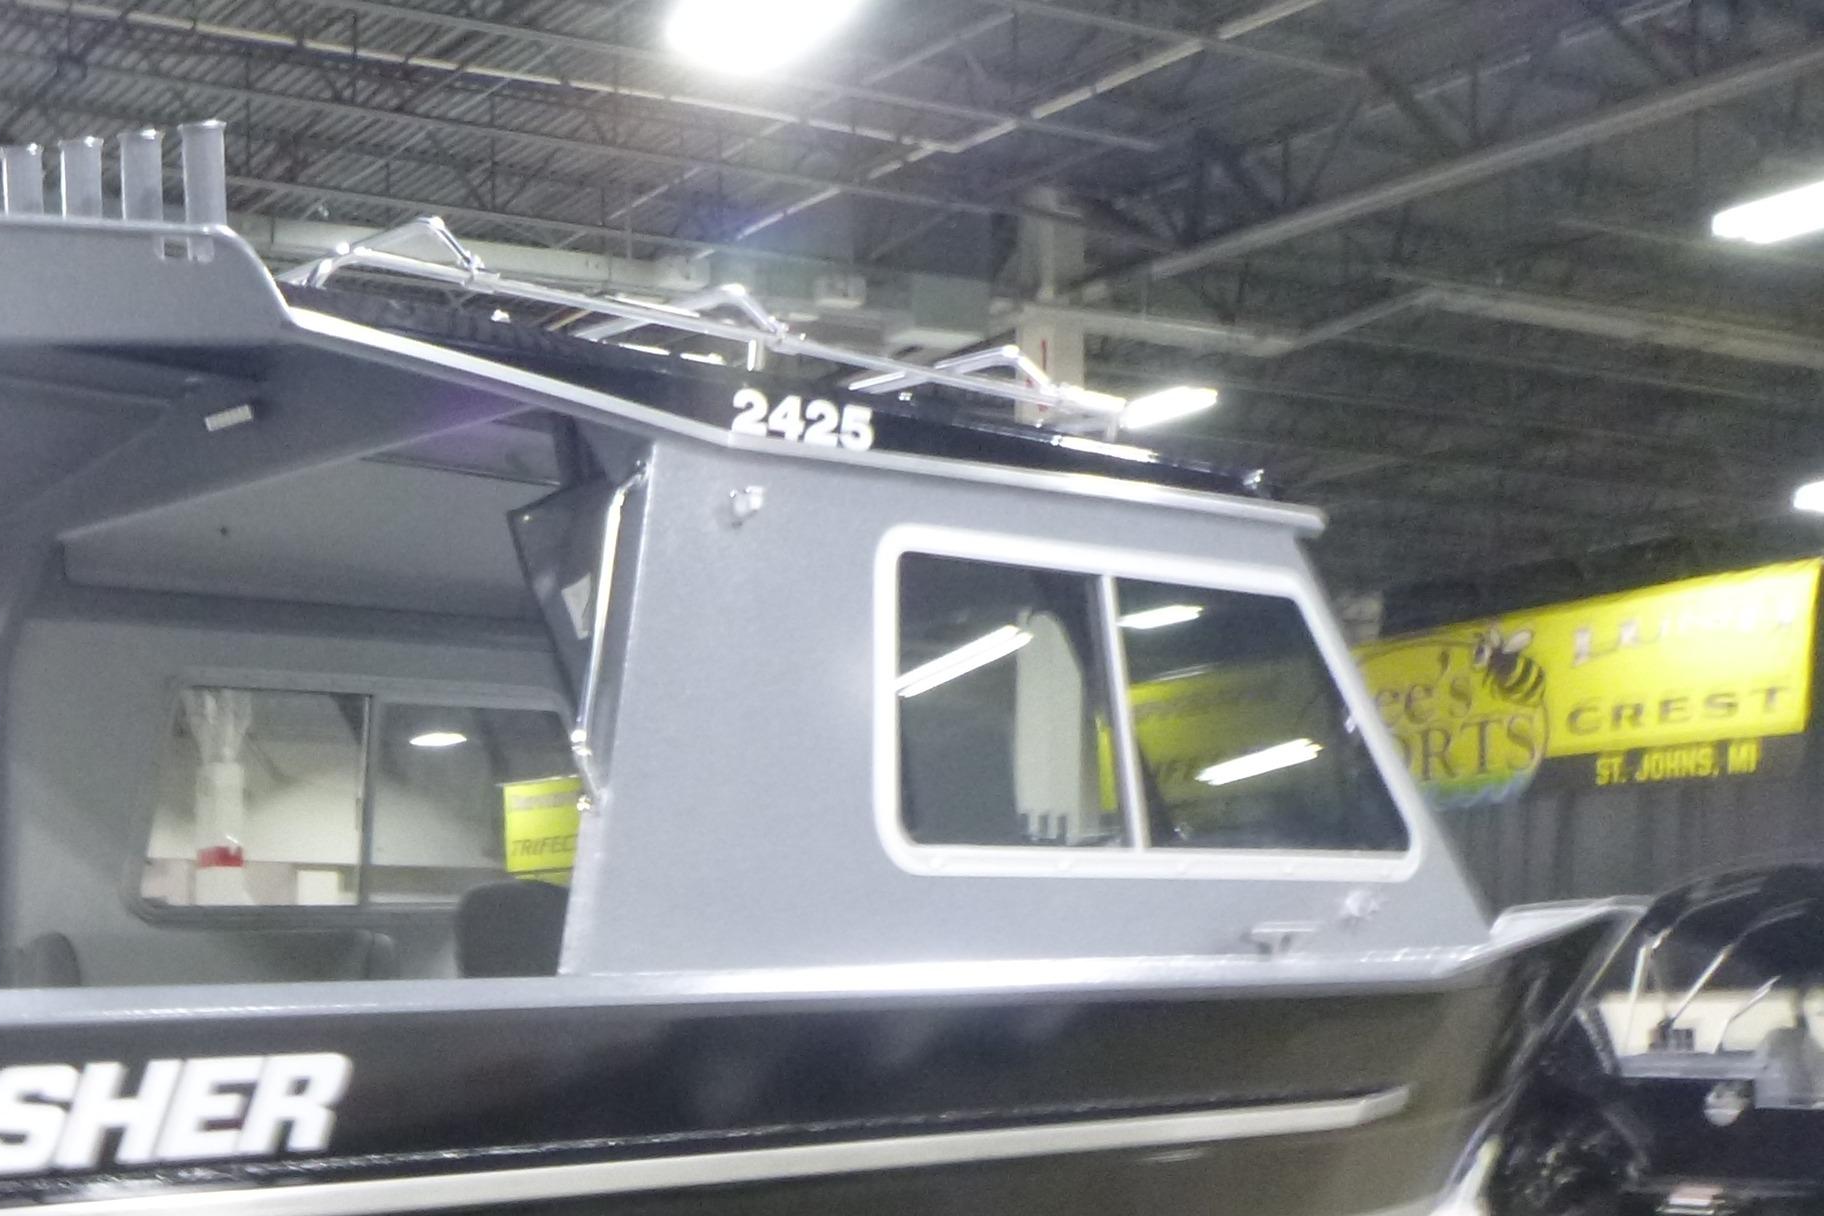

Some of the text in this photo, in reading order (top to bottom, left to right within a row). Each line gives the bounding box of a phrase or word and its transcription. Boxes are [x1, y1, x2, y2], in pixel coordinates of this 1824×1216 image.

[731, 388, 875, 453] 2425
[1567, 685, 1790, 736] CREST
[1728, 739, 1759, 775] MI
